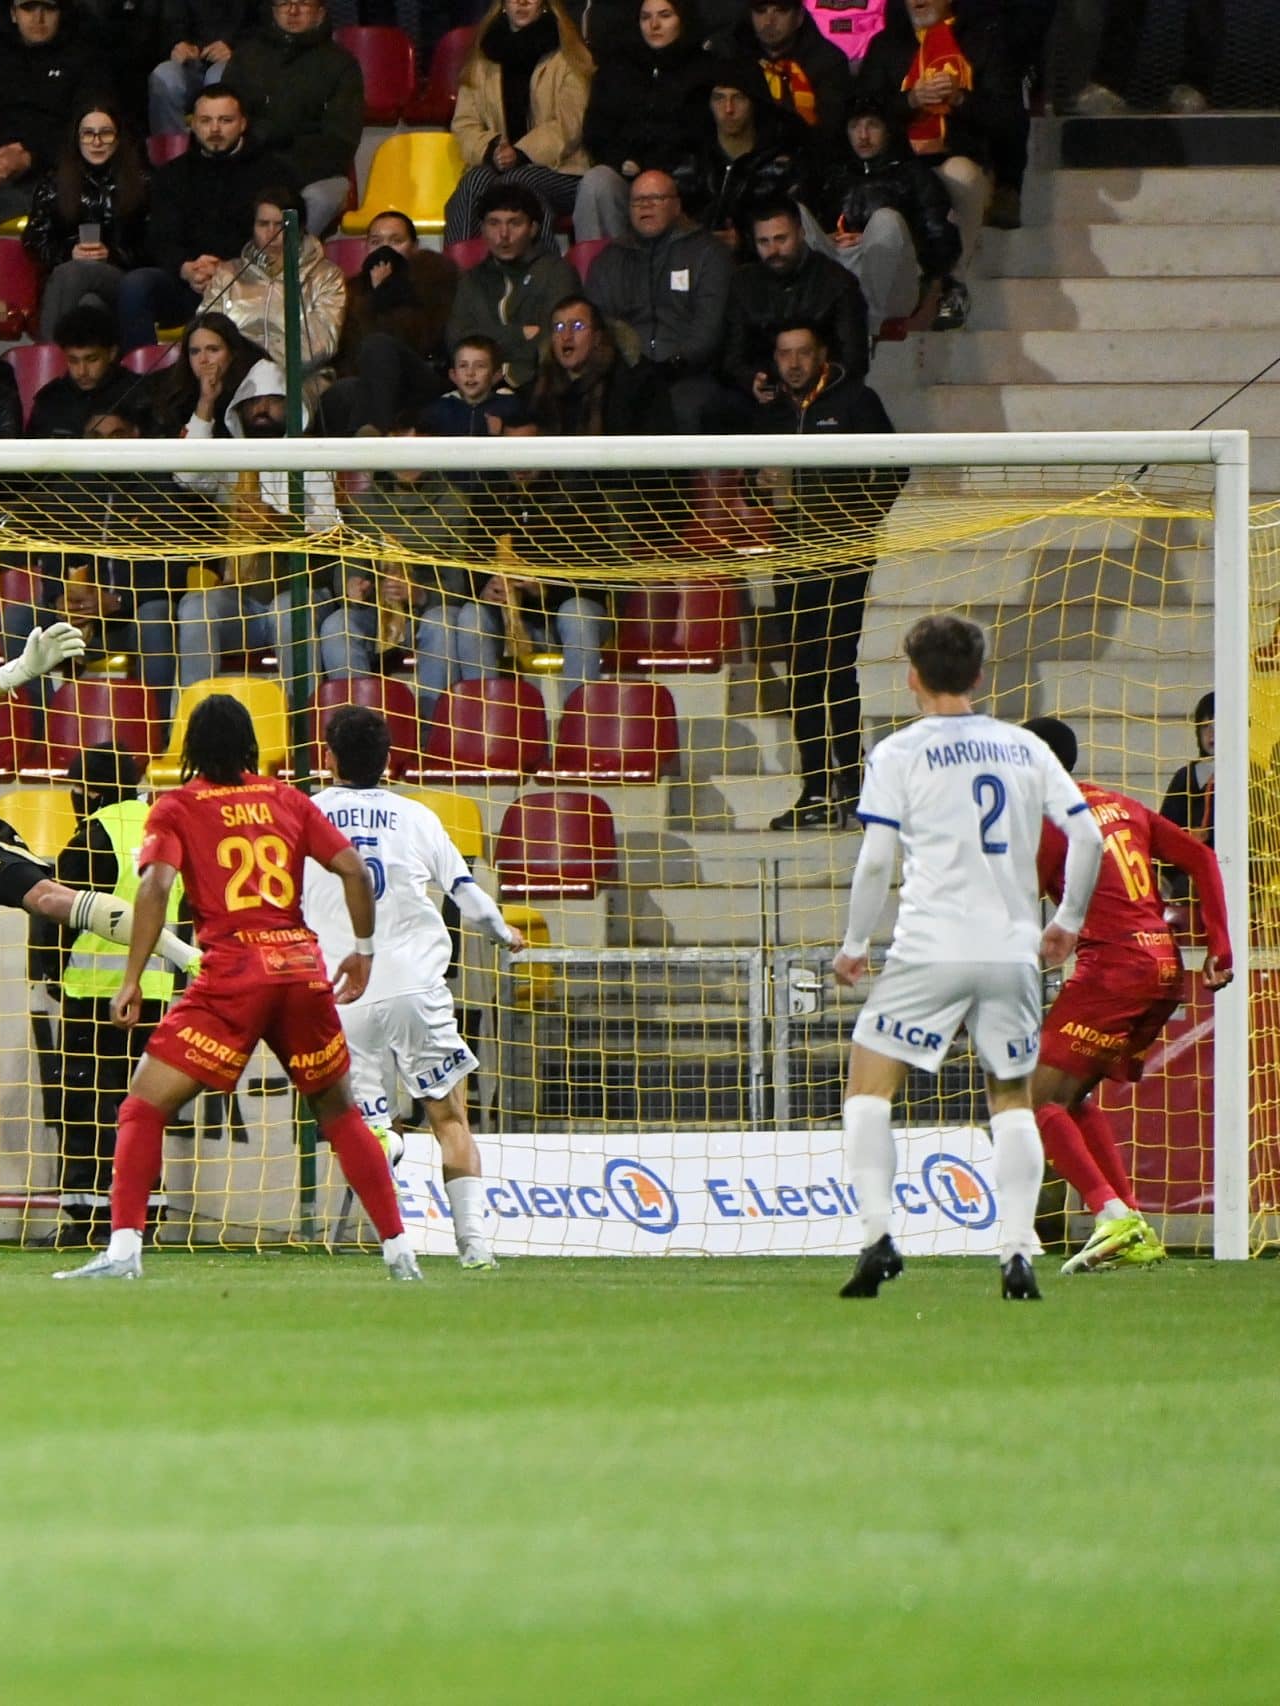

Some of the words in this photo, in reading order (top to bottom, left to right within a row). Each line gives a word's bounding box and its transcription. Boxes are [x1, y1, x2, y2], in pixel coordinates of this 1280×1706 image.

[926, 739, 1032, 771] MARONNIER
[220, 802, 274, 827] SAKA
[972, 773, 1008, 854] 2
[216, 835, 295, 912] 28
[350, 836, 386, 901] 5
[1104, 829, 1151, 902] 15
[892, 1021, 943, 1051] LCR
[433, 1048, 467, 1080] LCR
[397, 1179, 609, 1220] E.Lclerc
[704, 1177, 927, 1217] E.Leclc
